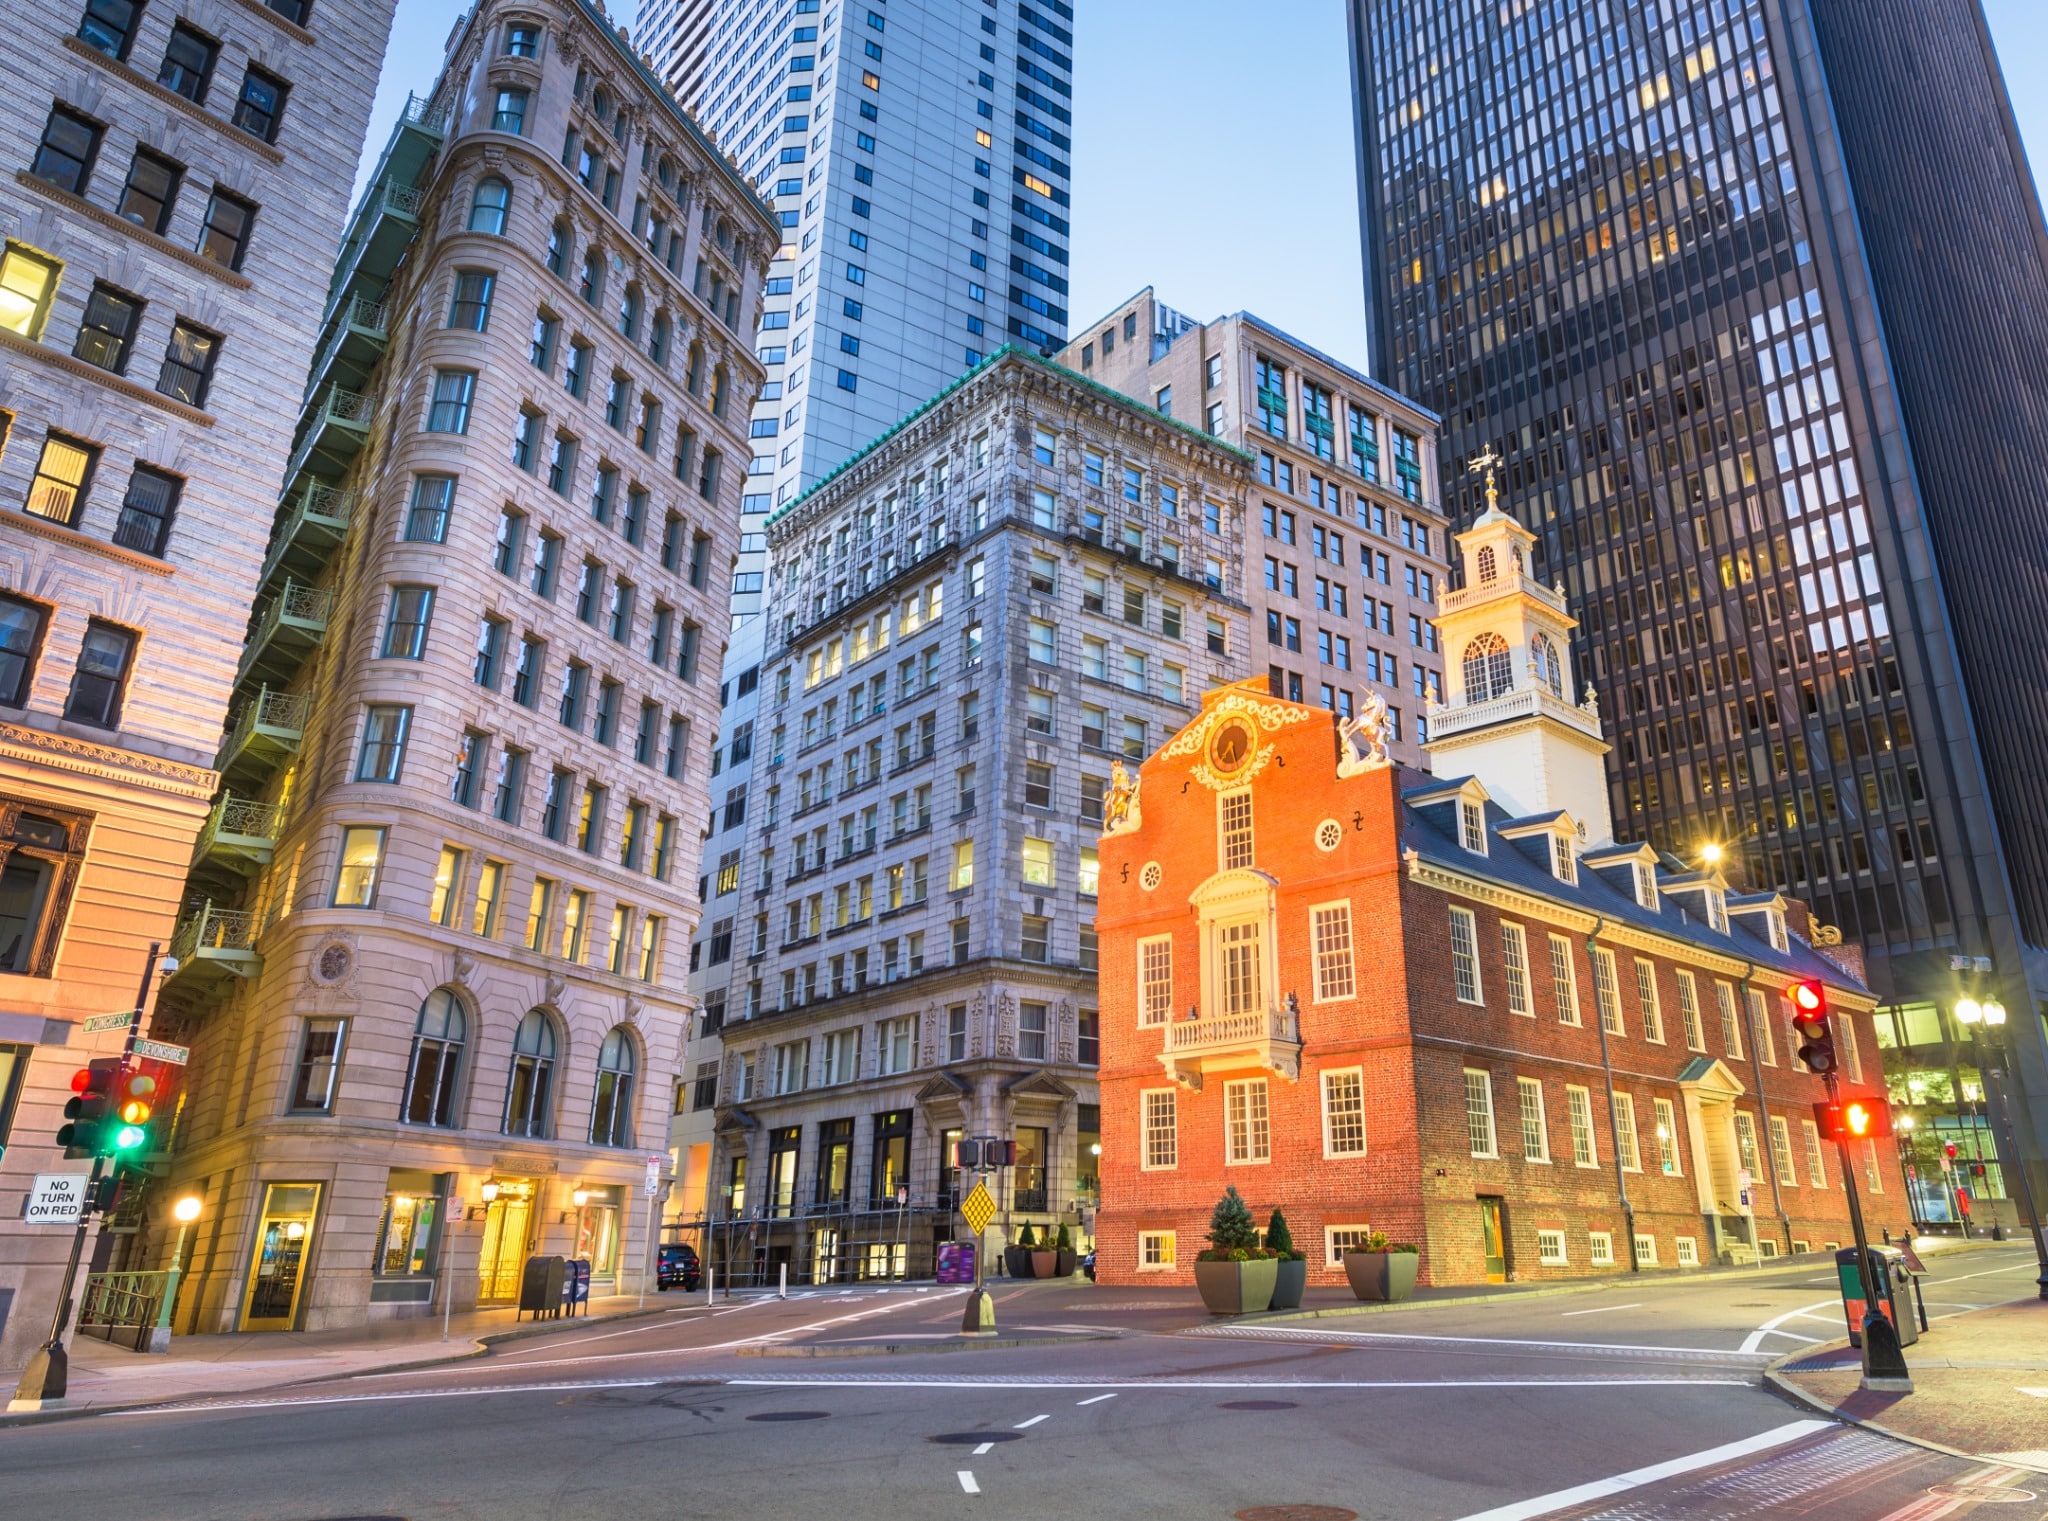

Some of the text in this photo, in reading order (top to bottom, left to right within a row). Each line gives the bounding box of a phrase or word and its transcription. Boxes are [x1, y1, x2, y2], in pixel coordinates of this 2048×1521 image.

[91, 1014, 126, 1030] CONGRESS
[141, 1041, 182, 1061] DEVONSHIRE
[50, 1181, 69, 1191] NO
[41, 1193, 75, 1203] TURN
[30, 1205, 78, 1216] ON RED
